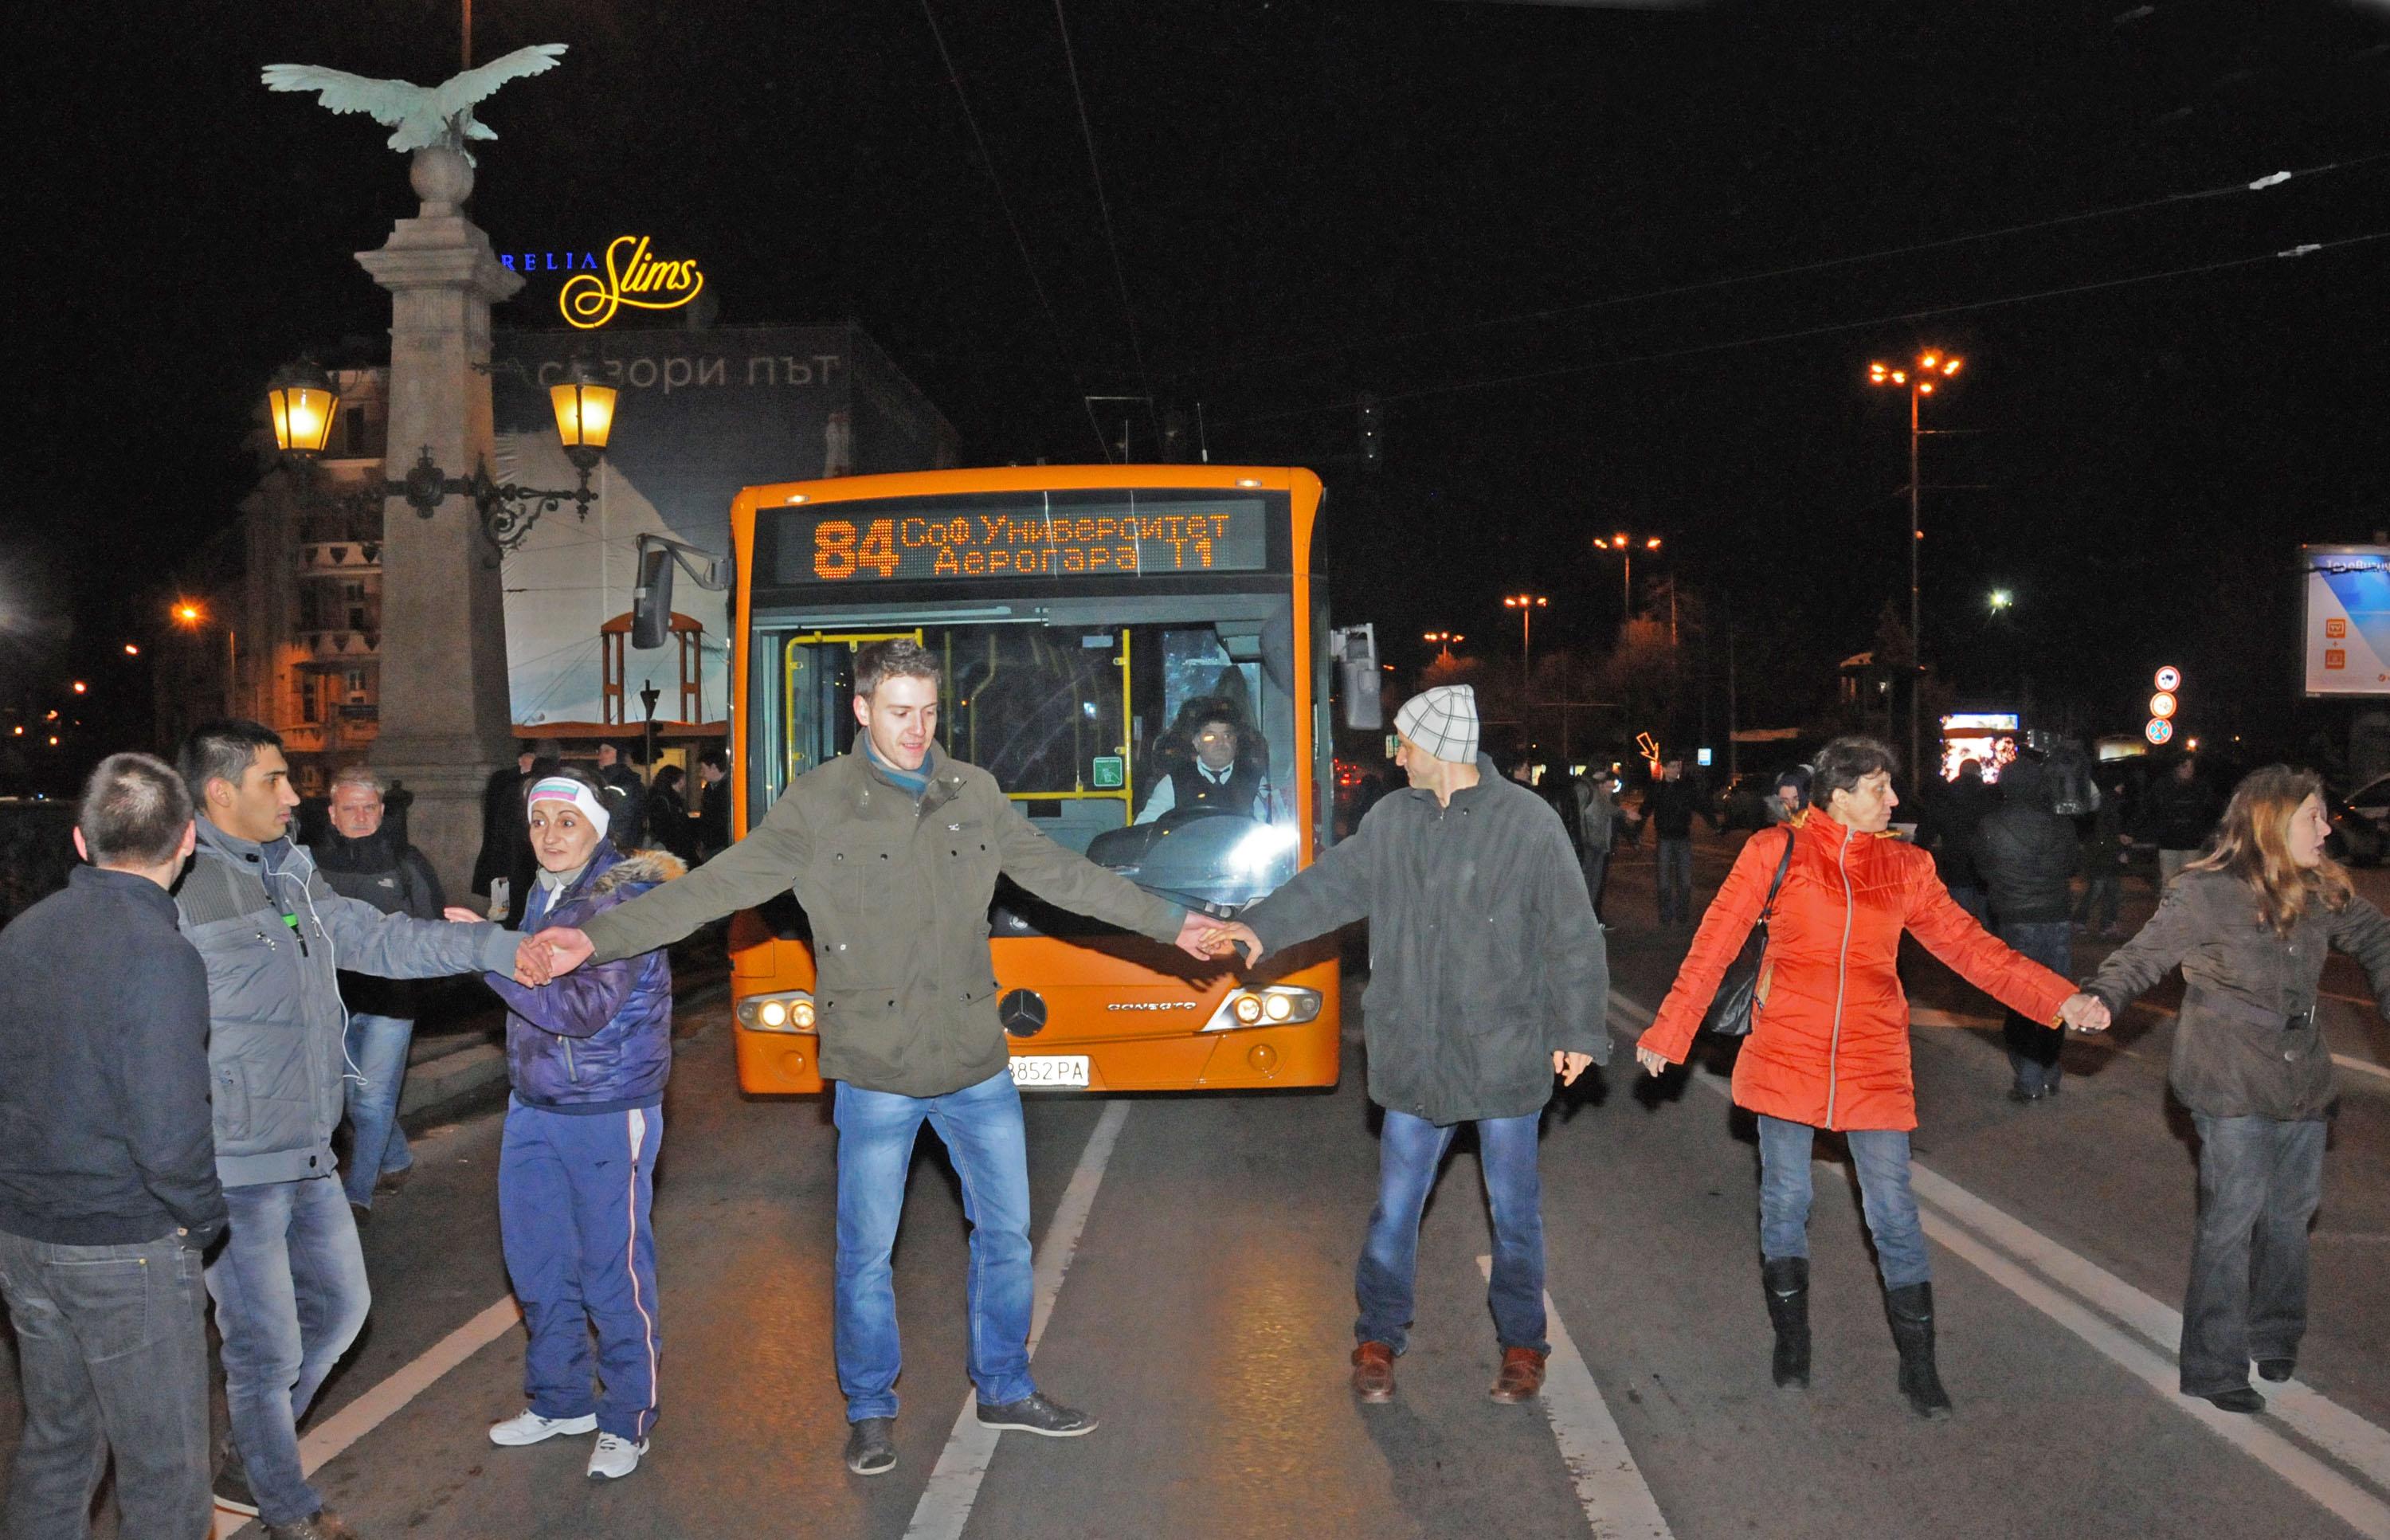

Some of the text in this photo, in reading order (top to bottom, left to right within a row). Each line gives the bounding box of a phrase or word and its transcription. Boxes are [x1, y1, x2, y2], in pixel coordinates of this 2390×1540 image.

[560, 235, 703, 328] Slims
[747, 355, 841, 387] път
[813, 519, 900, 579] 84
[934, 546, 1138, 576] Аерогара
[1058, 1061, 1083, 1080] PA
